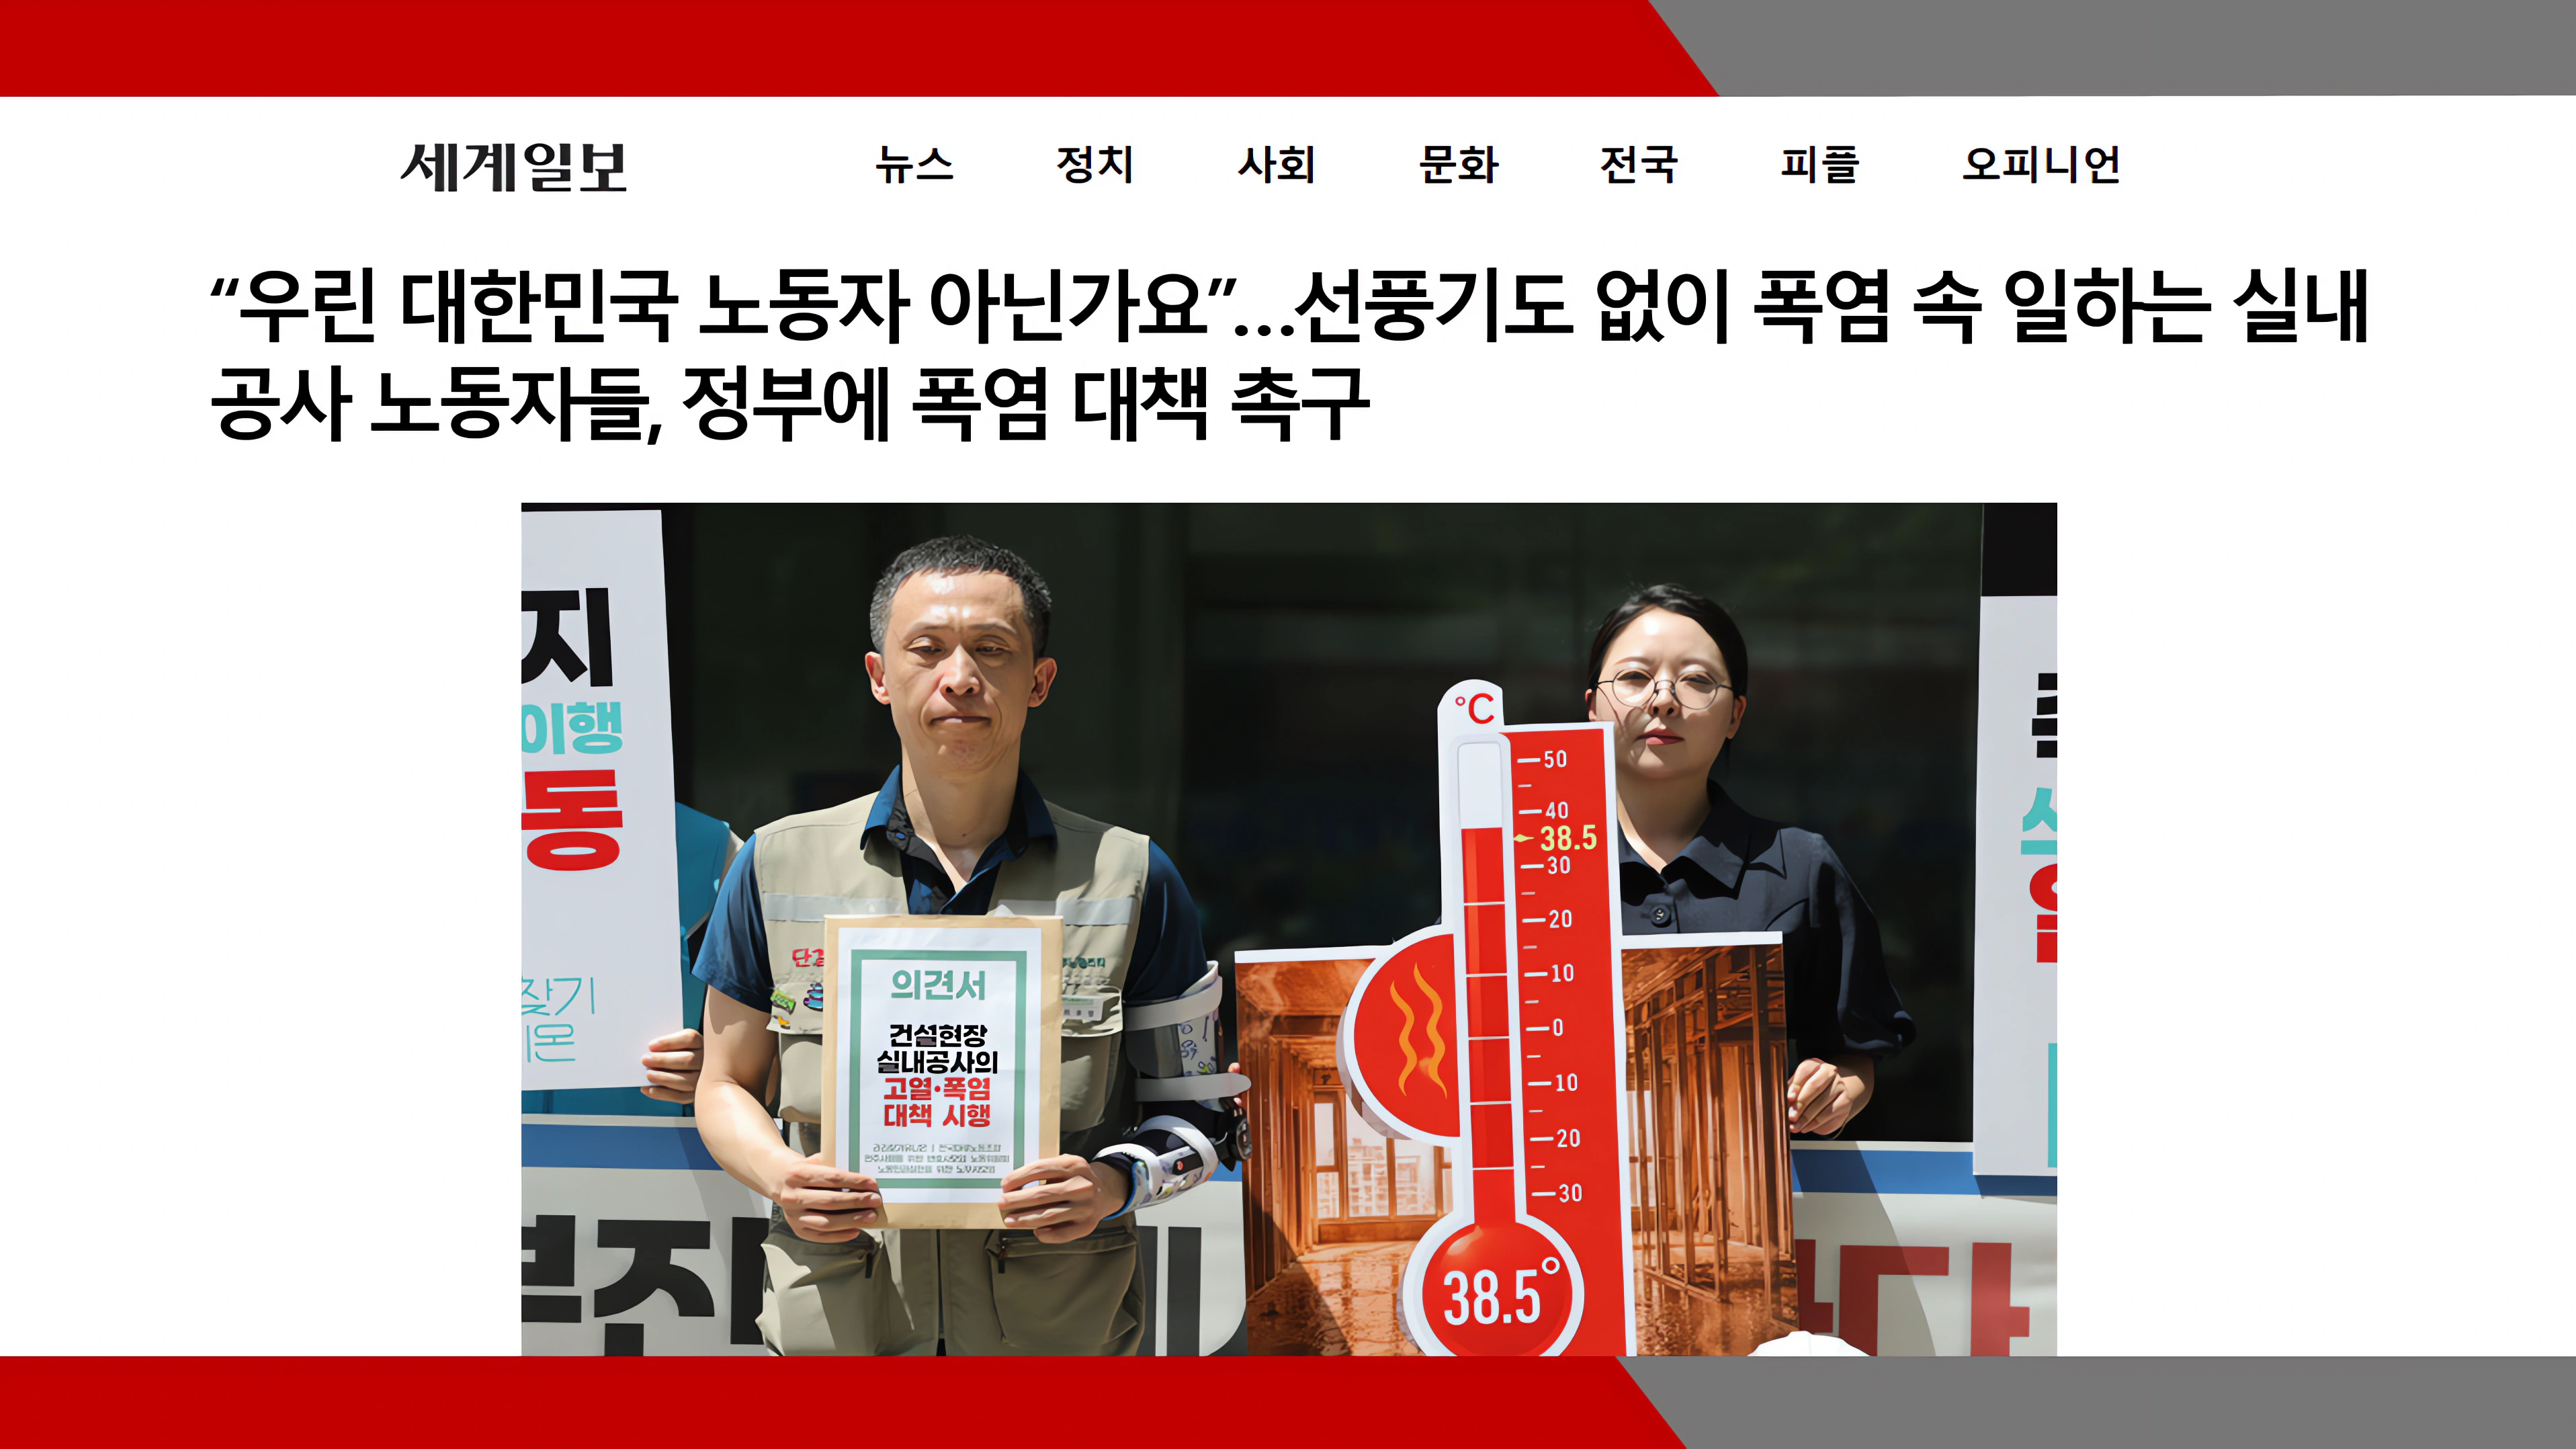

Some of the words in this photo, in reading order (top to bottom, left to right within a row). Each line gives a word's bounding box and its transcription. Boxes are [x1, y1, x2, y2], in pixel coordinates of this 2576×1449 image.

[1545, 750, 1567, 768] 50
[1545, 802, 1568, 819] 40
[1541, 825, 1597, 851] 38.5
[1547, 856, 1571, 874] 30
[1549, 909, 1572, 928] 20
[1552, 964, 1574, 982] 10
[891, 970, 986, 1000] 의견서
[890, 1024, 988, 1048] 건설현장
[1553, 1018, 1563, 1036] 0
[877, 1050, 998, 1075] 실내공사의
[1555, 1073, 1578, 1091] 10
[884, 1104, 932, 1128] 대책
[942, 1104, 991, 1128] 시행
[1557, 1128, 1580, 1148] 20
[1559, 1183, 1583, 1203] 30
